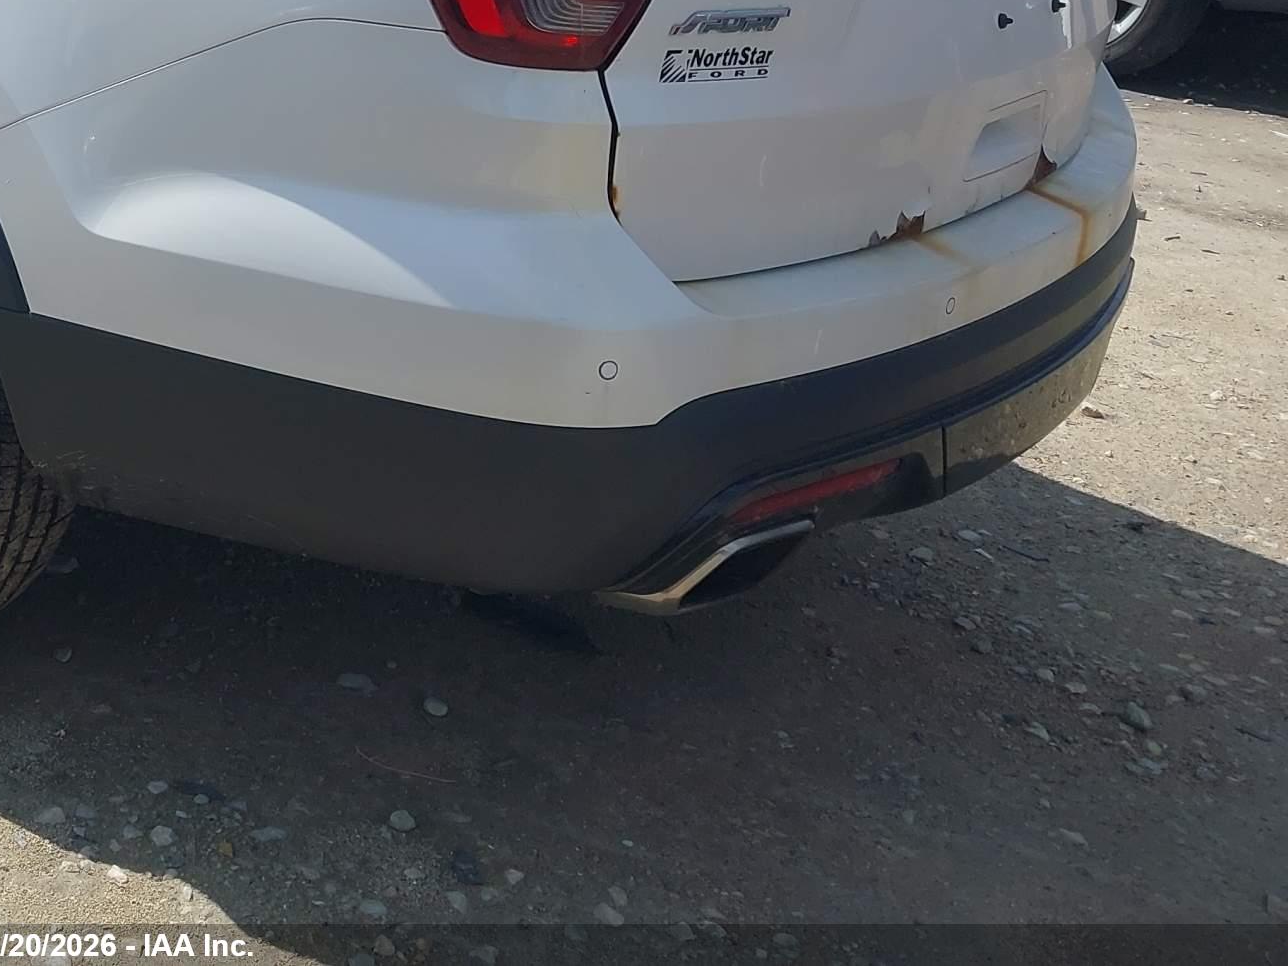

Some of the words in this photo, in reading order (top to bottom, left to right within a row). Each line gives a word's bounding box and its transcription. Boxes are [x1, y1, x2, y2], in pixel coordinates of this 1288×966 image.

[669, 8, 791, 35] SPORT
[690, 46, 774, 68] NorthStar
[688, 68, 769, 80] FORD
